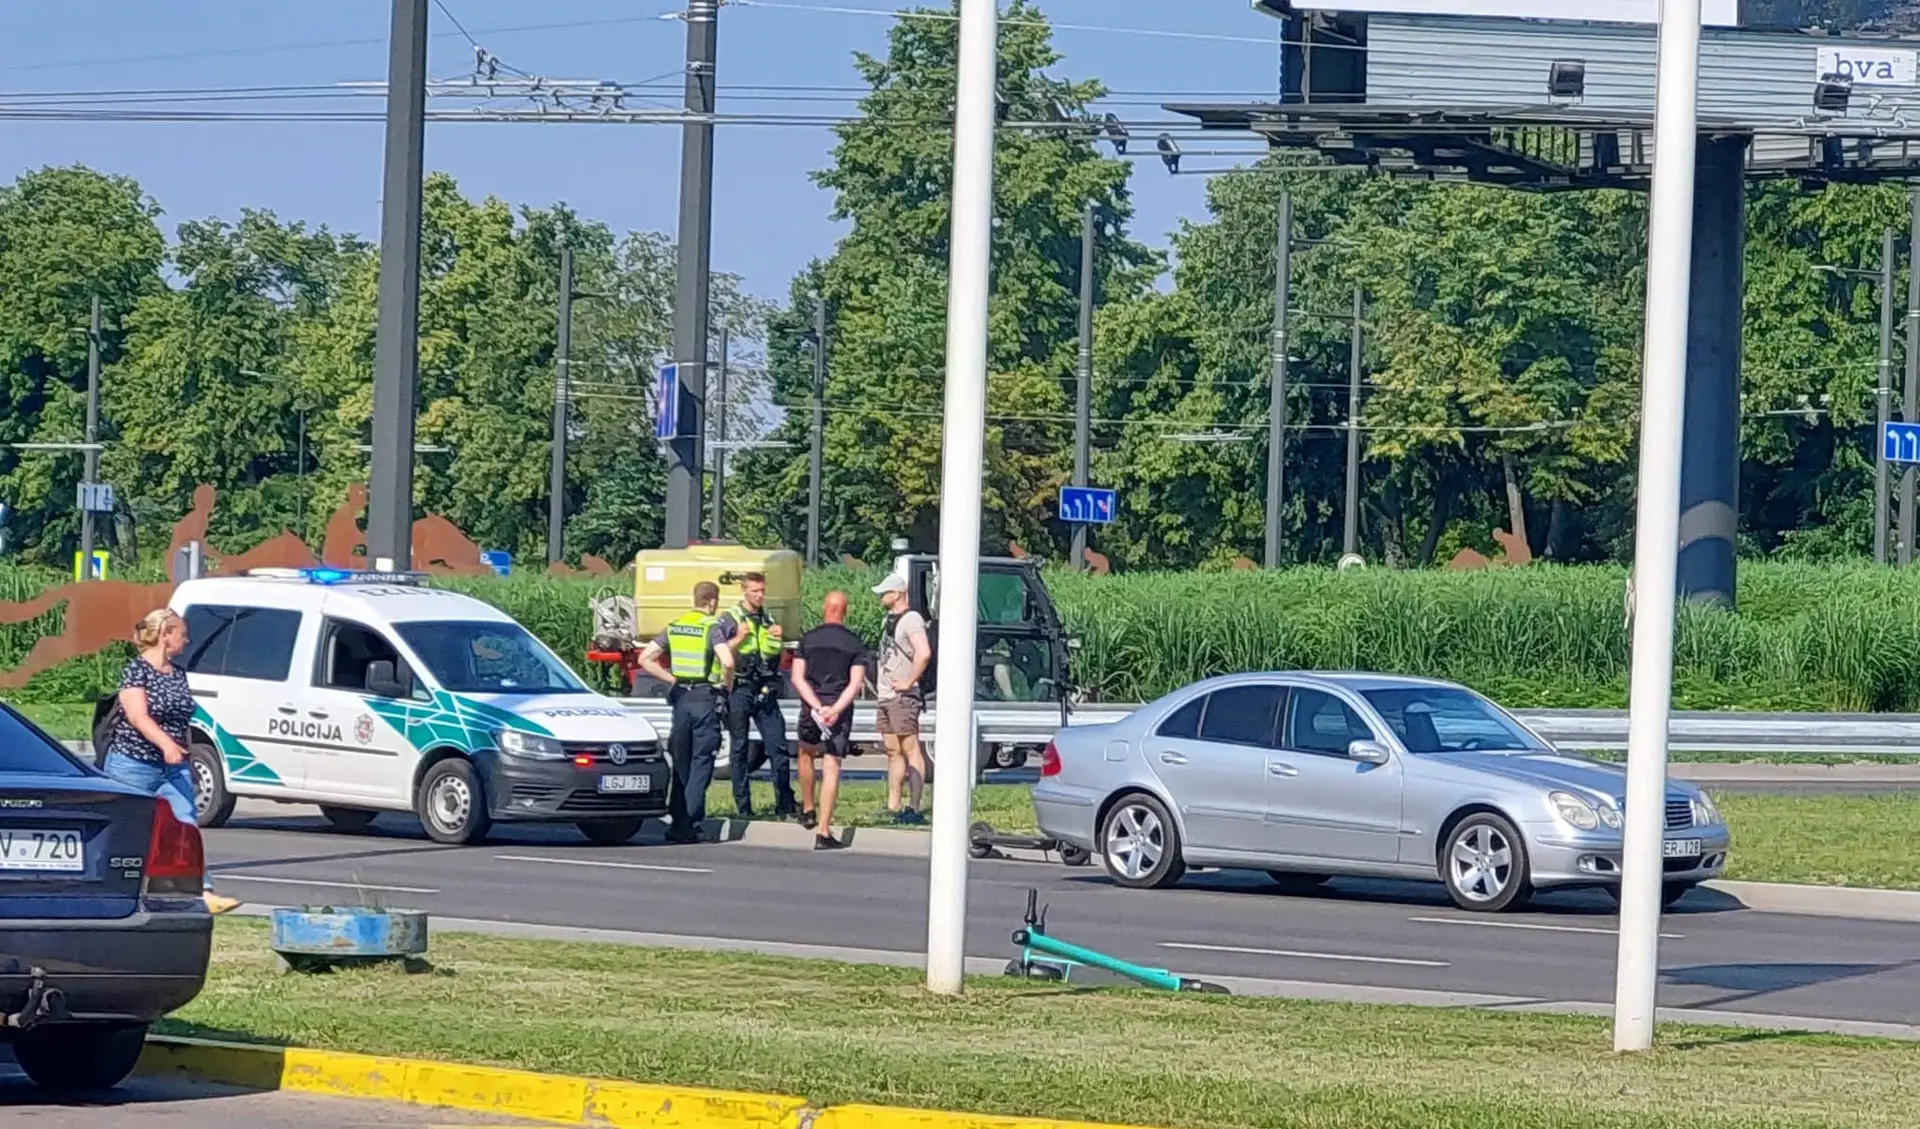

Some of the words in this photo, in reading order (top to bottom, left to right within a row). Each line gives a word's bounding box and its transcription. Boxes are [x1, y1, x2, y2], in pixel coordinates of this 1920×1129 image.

[1834, 52, 1894, 79] bva
[268, 718, 343, 742] POLICIJA
[604, 776, 626, 789] LGJ
[31, 832, 78, 859] 720
[109, 857, 143, 868] S60
